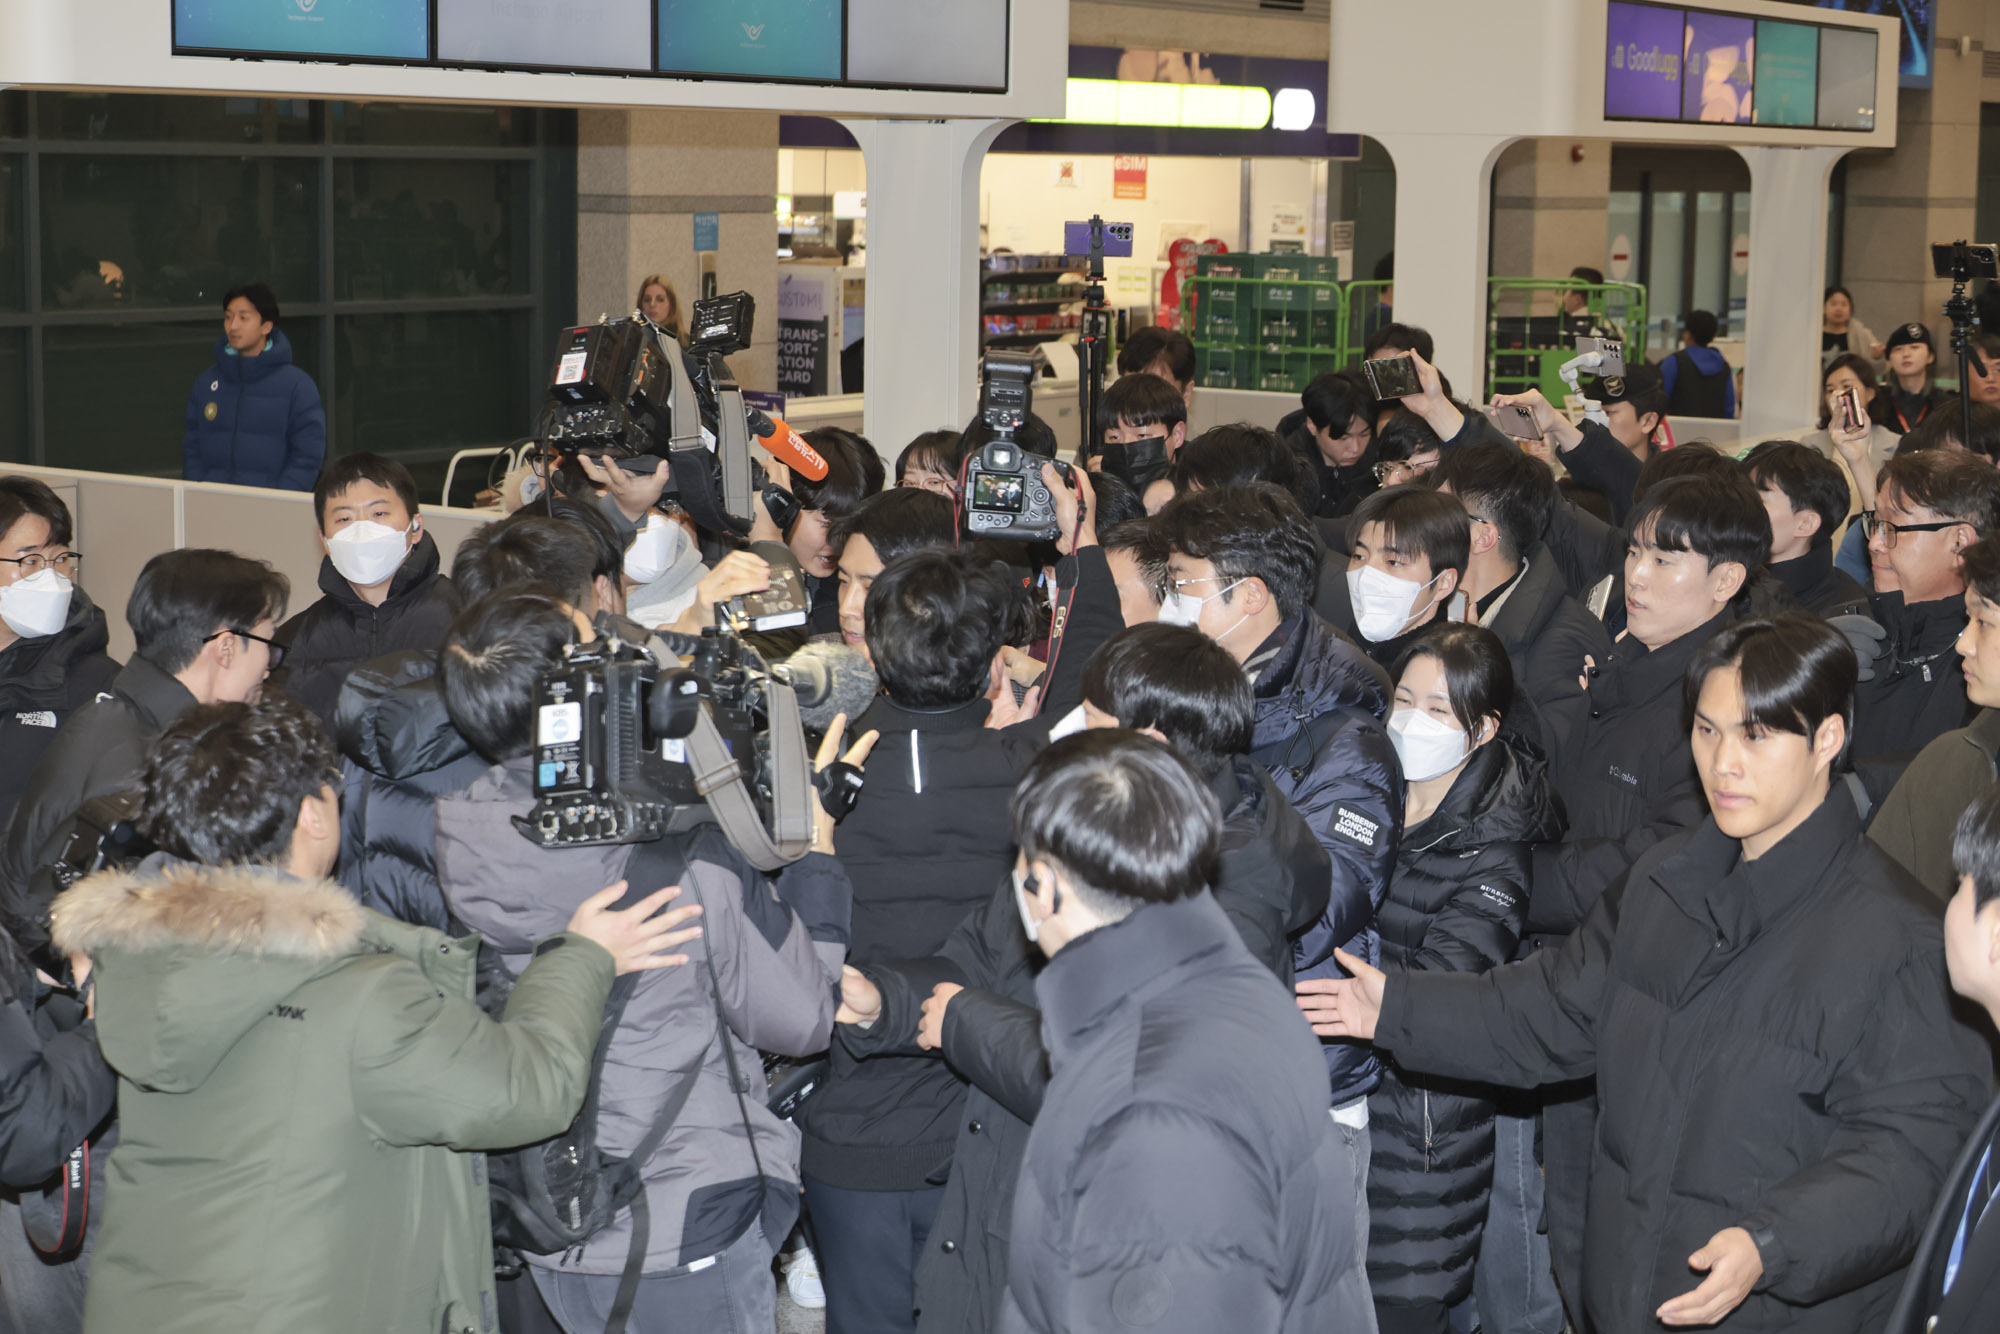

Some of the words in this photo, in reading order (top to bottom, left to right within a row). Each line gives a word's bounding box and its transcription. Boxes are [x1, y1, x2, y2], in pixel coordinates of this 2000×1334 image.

[1627, 42, 1679, 81] Goodlugg
[1053, 606, 1067, 639] EOS
[16, 712, 43, 720] NORTH
[1338, 807, 1379, 832] BURBERRY
[1339, 817, 1374, 838] LONDON
[1334, 823, 1374, 846] ENGLAND
[1479, 884, 1517, 905] BURBERRY
